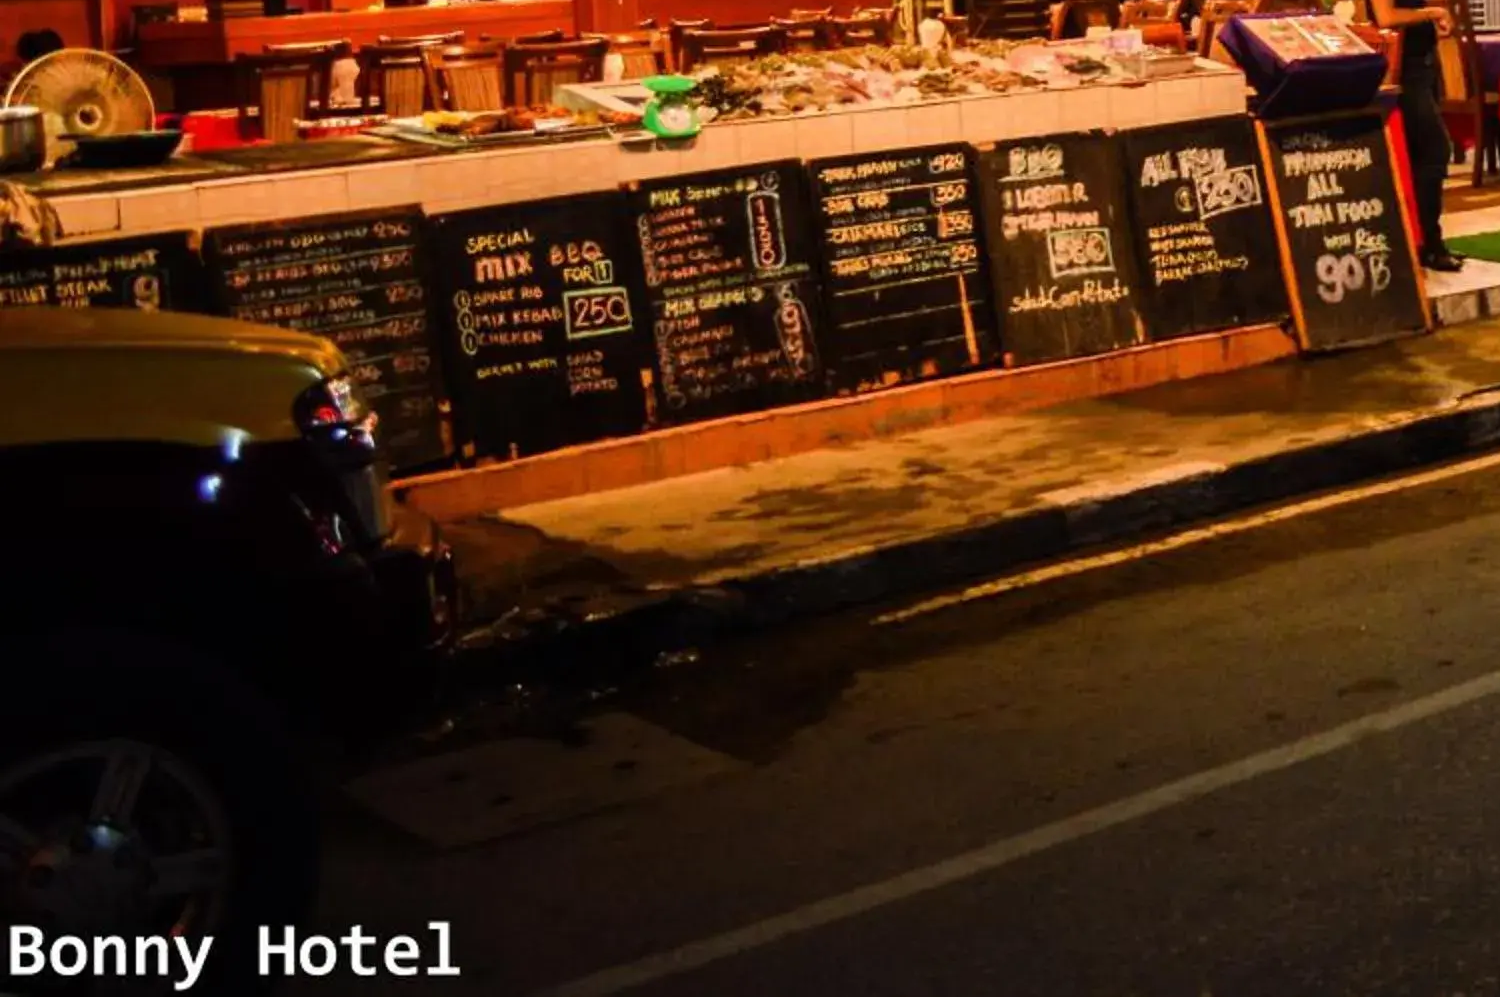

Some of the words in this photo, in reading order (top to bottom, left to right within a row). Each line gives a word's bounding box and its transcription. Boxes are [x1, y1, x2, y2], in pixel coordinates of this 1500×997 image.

[1141, 150, 1178, 187] ALL
[1307, 173, 1344, 201] ALL
[1288, 202, 1334, 228] THAI
[1336, 198, 1384, 224] FOOD
[465, 227, 535, 255] SPECIAL
[548, 240, 605, 267] BBQ
[562, 264, 594, 284] FOR
[1315, 254, 1365, 304] 90
[573, 295, 629, 328] 250
[480, 329, 544, 347] CHICKEN
